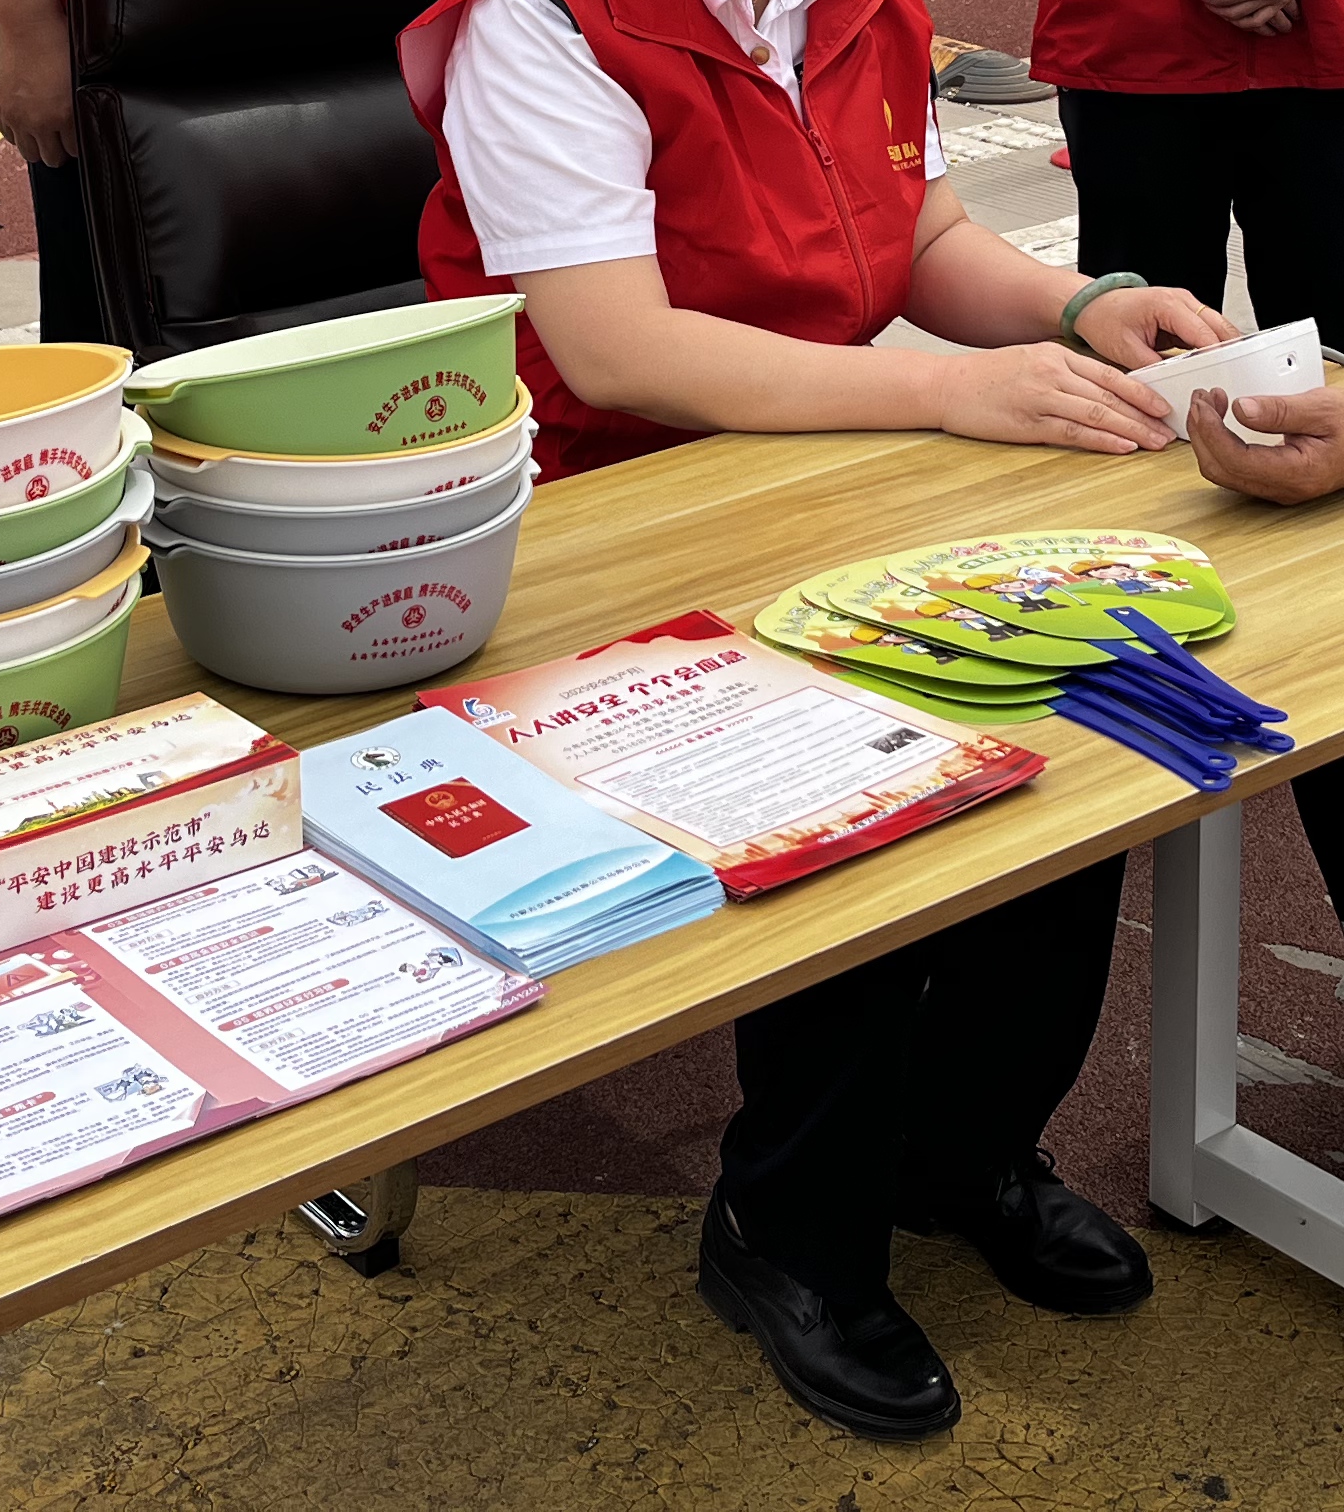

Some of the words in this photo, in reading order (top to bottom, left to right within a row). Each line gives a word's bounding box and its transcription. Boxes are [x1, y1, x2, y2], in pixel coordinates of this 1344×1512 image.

[367, 375, 432, 435] 安全生产进家庭
[341, 586, 413, 633] 安全生产进家庭
[8, 700, 72, 730] 携手共筑安全网
[508, 693, 628, 744] 人人讲安全
[628, 649, 748, 696] 个个会应急
[356, 757, 444, 796] 民法典
[35, 819, 271, 913] 建设更高水平平安乌达
